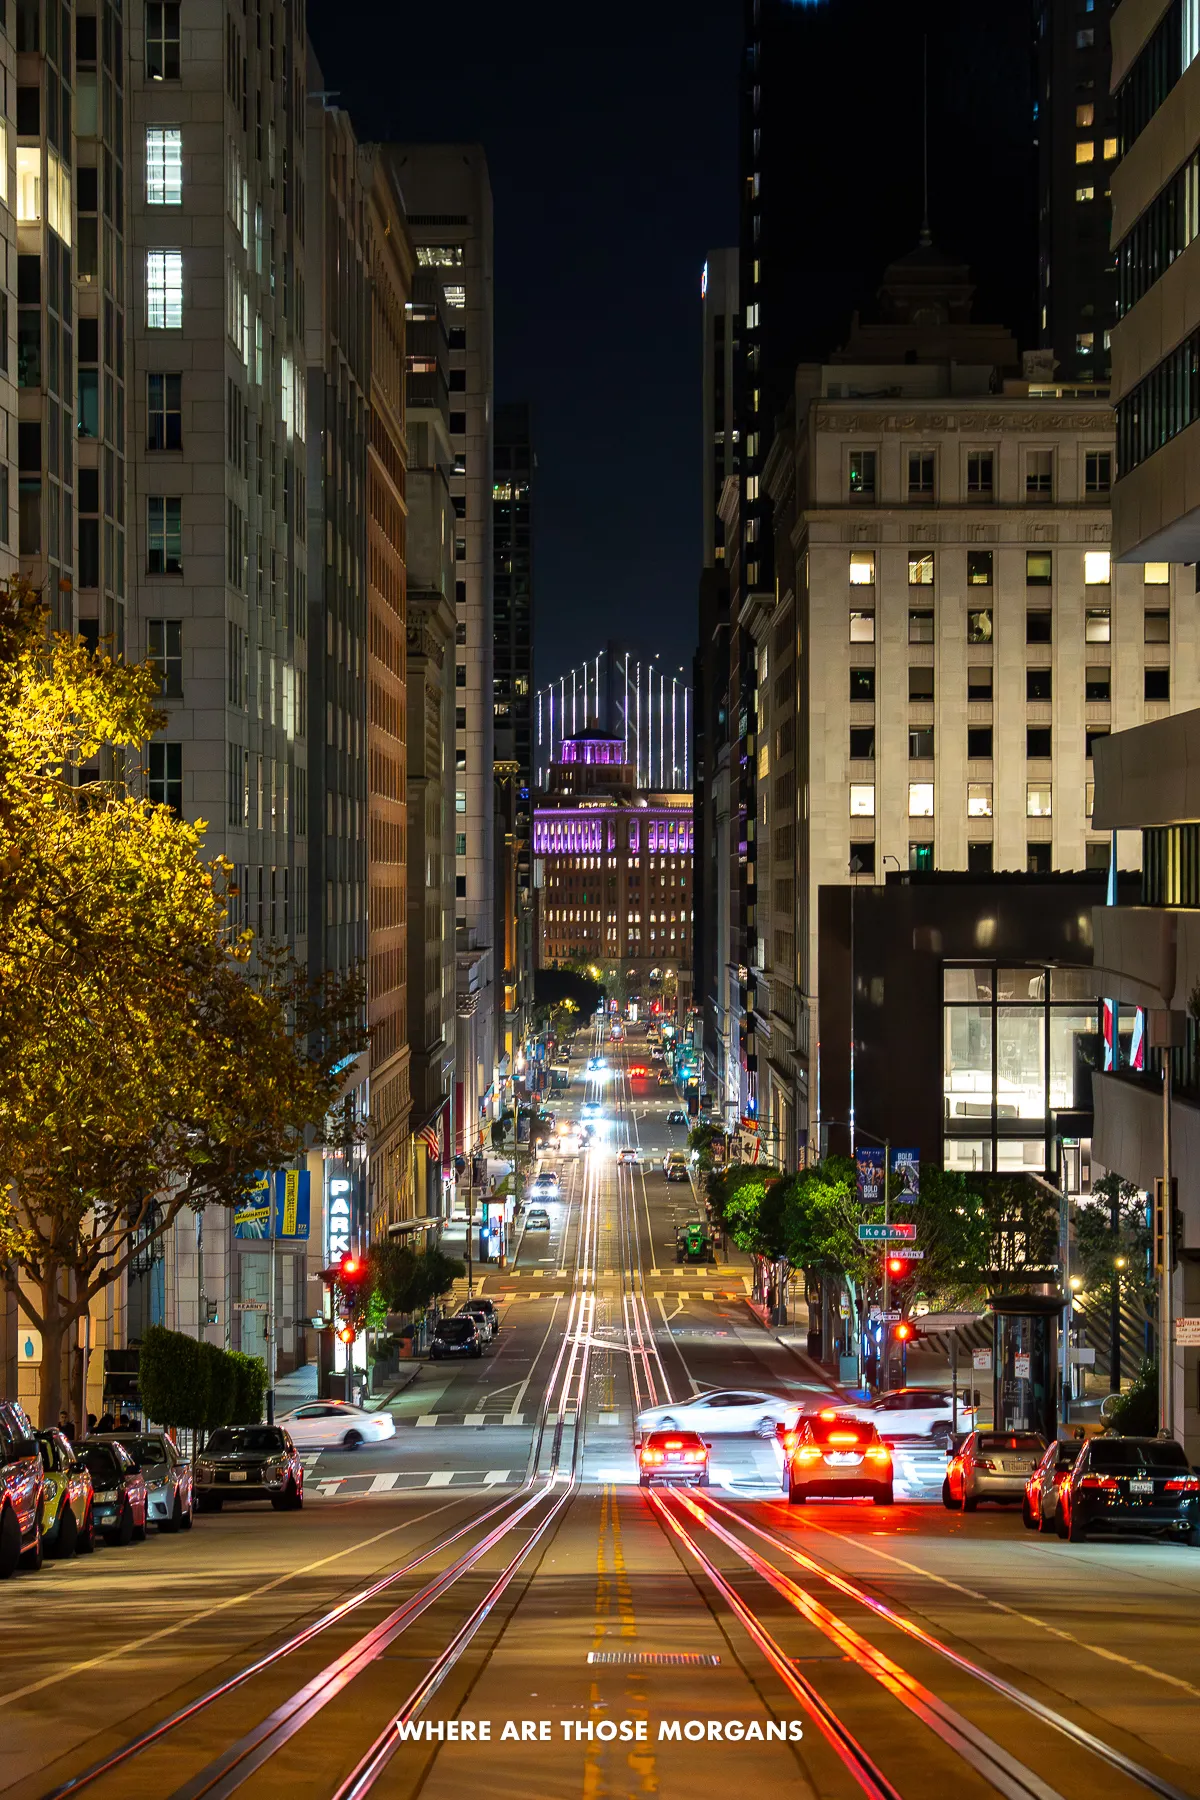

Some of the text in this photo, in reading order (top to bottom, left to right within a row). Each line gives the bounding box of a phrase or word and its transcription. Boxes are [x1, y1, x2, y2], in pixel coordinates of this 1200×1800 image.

[897, 1152, 912, 1160] BOLD
[863, 1184, 878, 1192] BOLD
[235, 1209, 269, 1221] IMAGINATIVE
[330, 1179, 350, 1251] PARK
[865, 1228, 909, 1238] Kearny
[1176, 1318, 1185, 1327] NO
